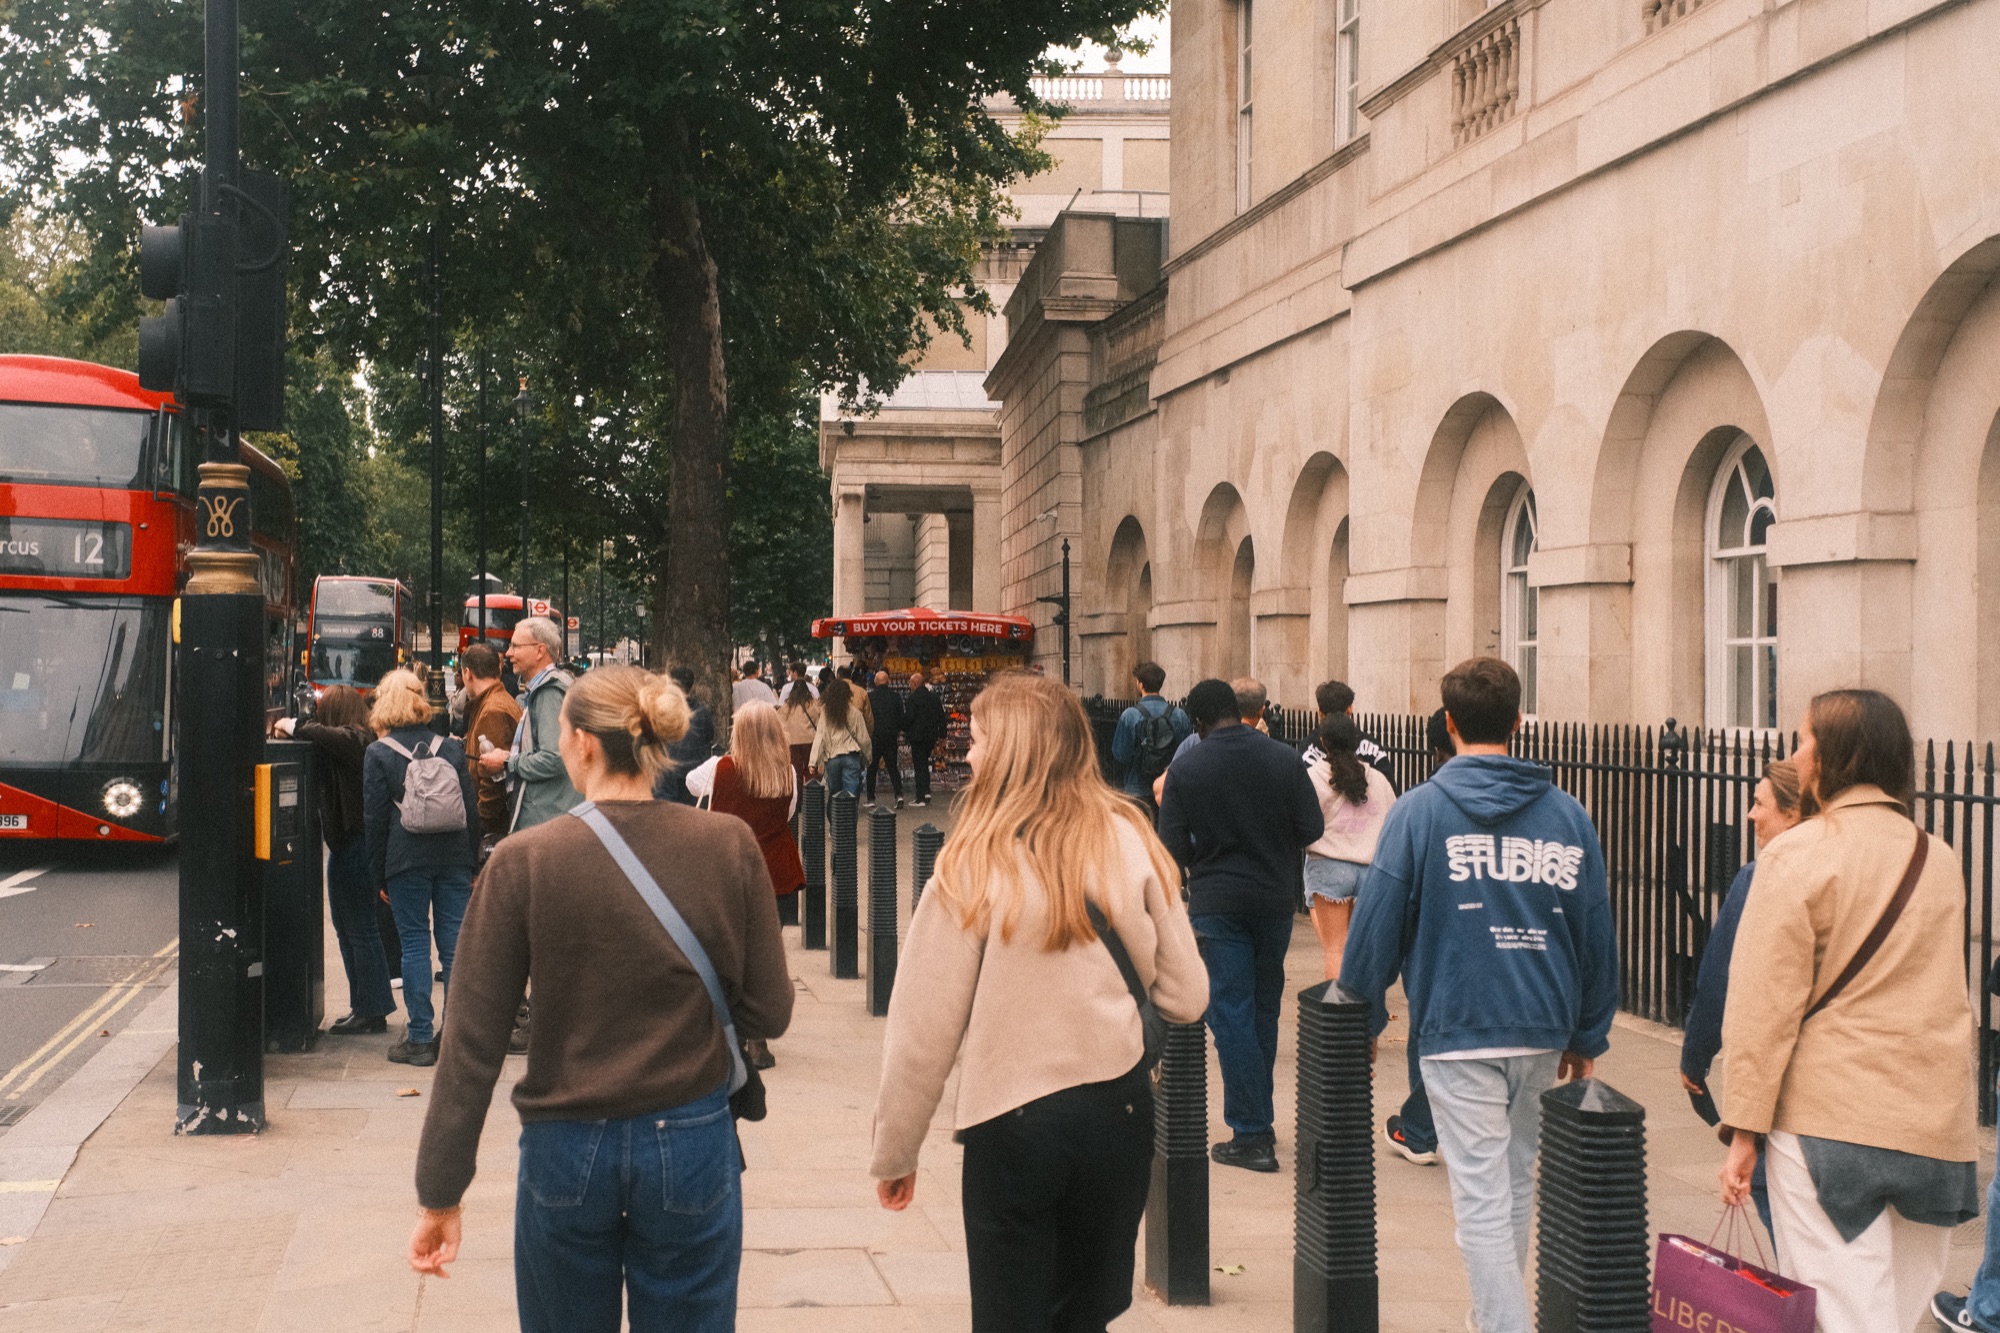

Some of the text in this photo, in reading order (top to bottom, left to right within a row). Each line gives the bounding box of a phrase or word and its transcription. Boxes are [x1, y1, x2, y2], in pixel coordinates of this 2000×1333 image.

[74, 532, 104, 564] 12
[371, 627, 384, 638] 88
[853, 620, 1003, 634] BUY YOUR TICKETS HERE
[1445, 834, 1584, 890] STUDIOS
